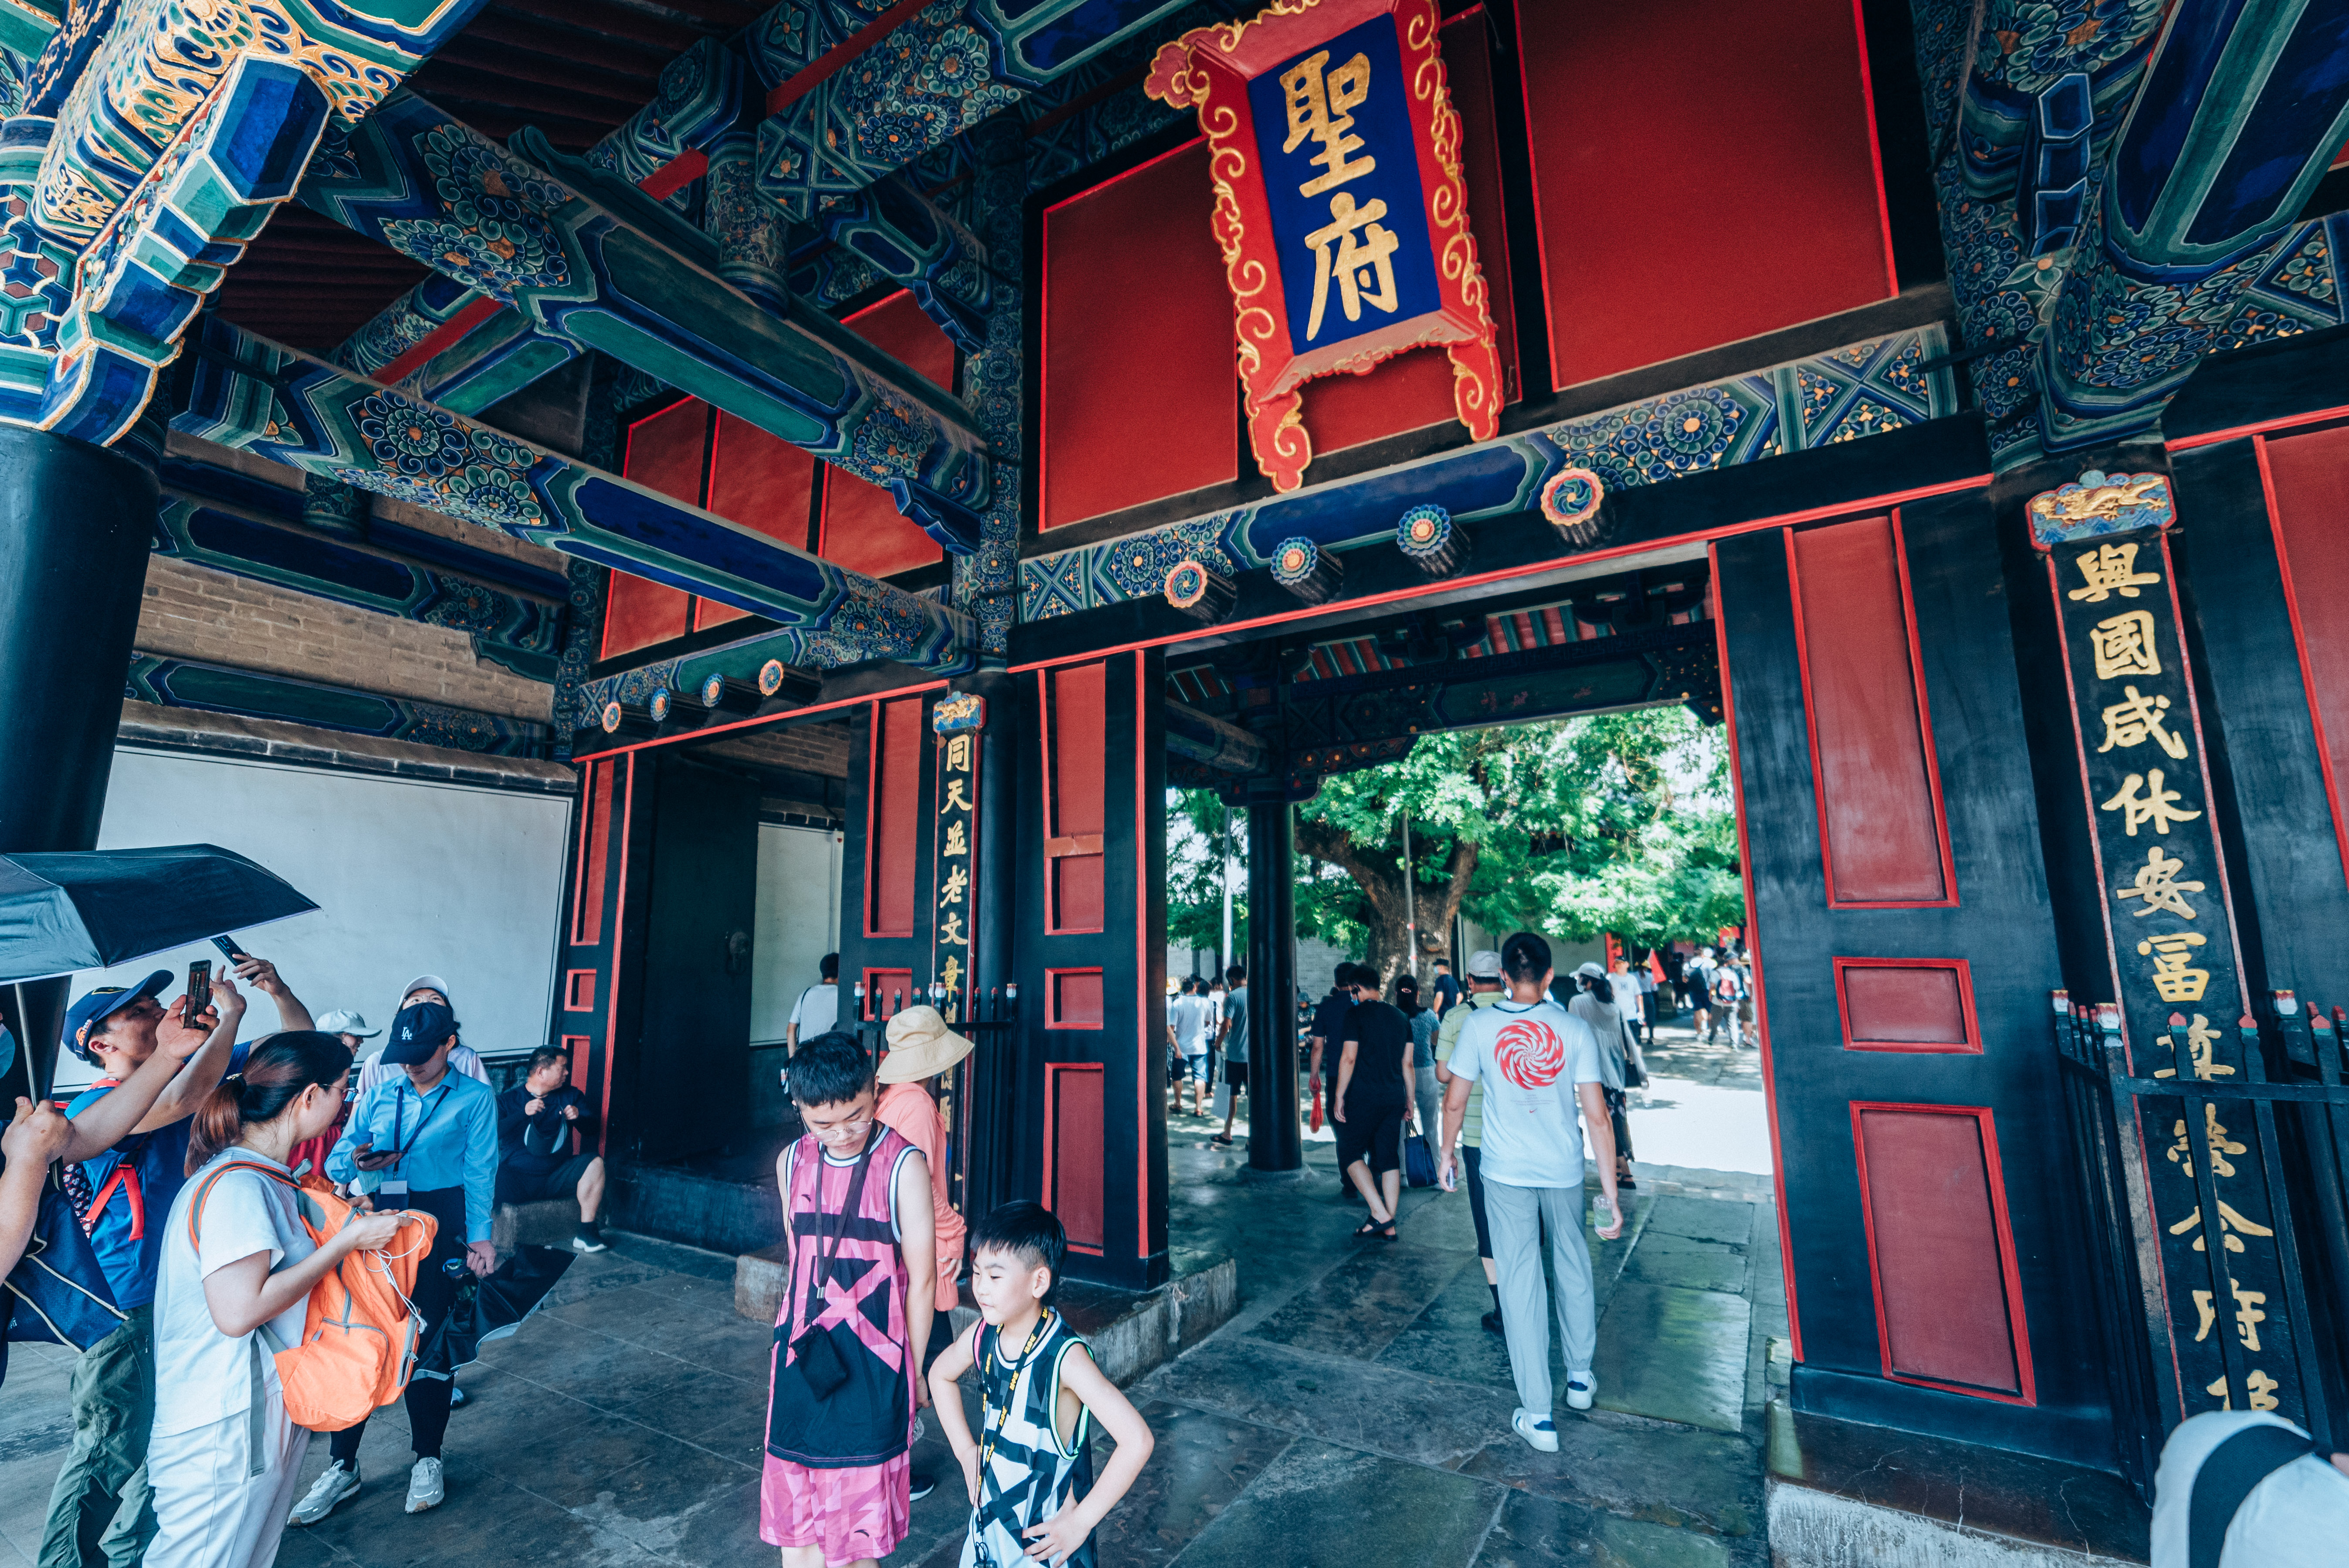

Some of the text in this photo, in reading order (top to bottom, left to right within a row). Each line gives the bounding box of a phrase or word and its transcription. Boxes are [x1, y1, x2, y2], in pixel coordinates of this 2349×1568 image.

[1278, 50, 1399, 341] 聖府
[401, 1026, 412, 1040] LA
[940, 734, 972, 1132] 同天並老文章
